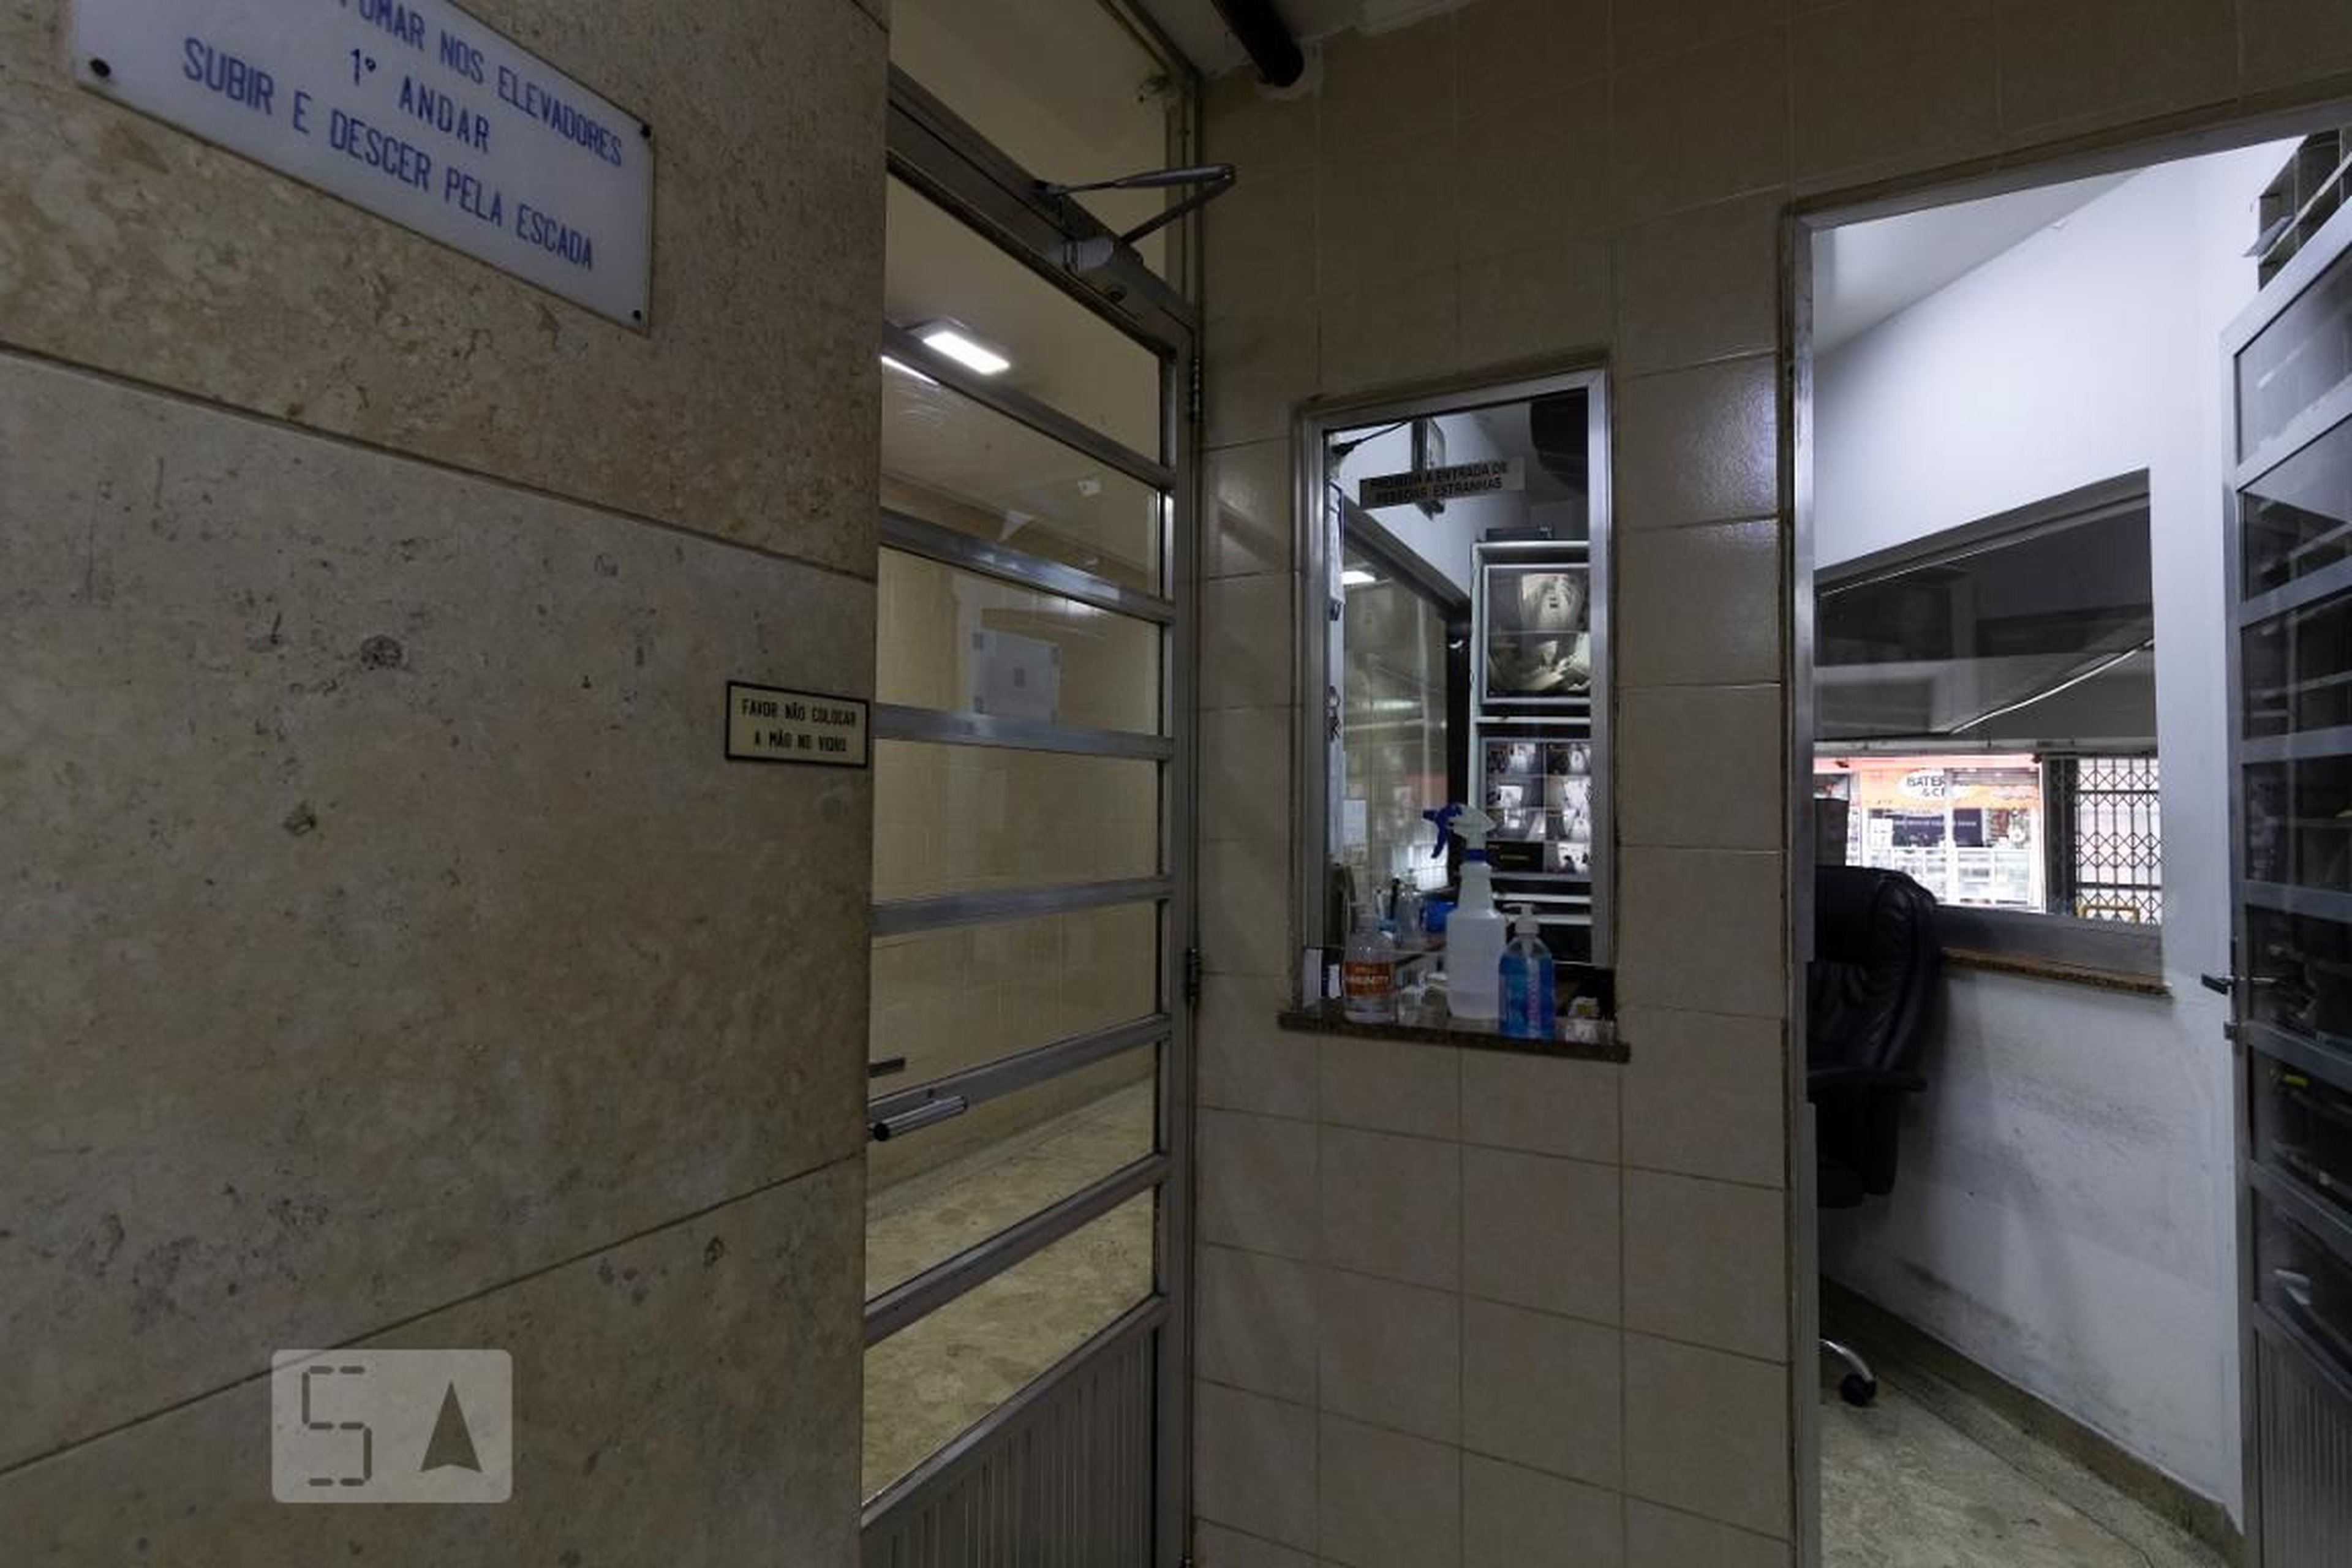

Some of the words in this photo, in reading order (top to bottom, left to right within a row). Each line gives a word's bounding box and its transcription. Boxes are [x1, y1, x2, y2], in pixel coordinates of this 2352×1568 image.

[342, 0, 425, 52] UMAR
[440, 29, 484, 85] NOS
[498, 64, 622, 167] ELEVADORES
[398, 74, 489, 154] ANDAR
[184, 37, 274, 115] SUBIR
[293, 89, 312, 135] E
[330, 108, 432, 192] DESCER
[445, 167, 502, 228] PELA
[516, 203, 593, 271] ESCADA
[785, 701, 806, 722] NÃO
